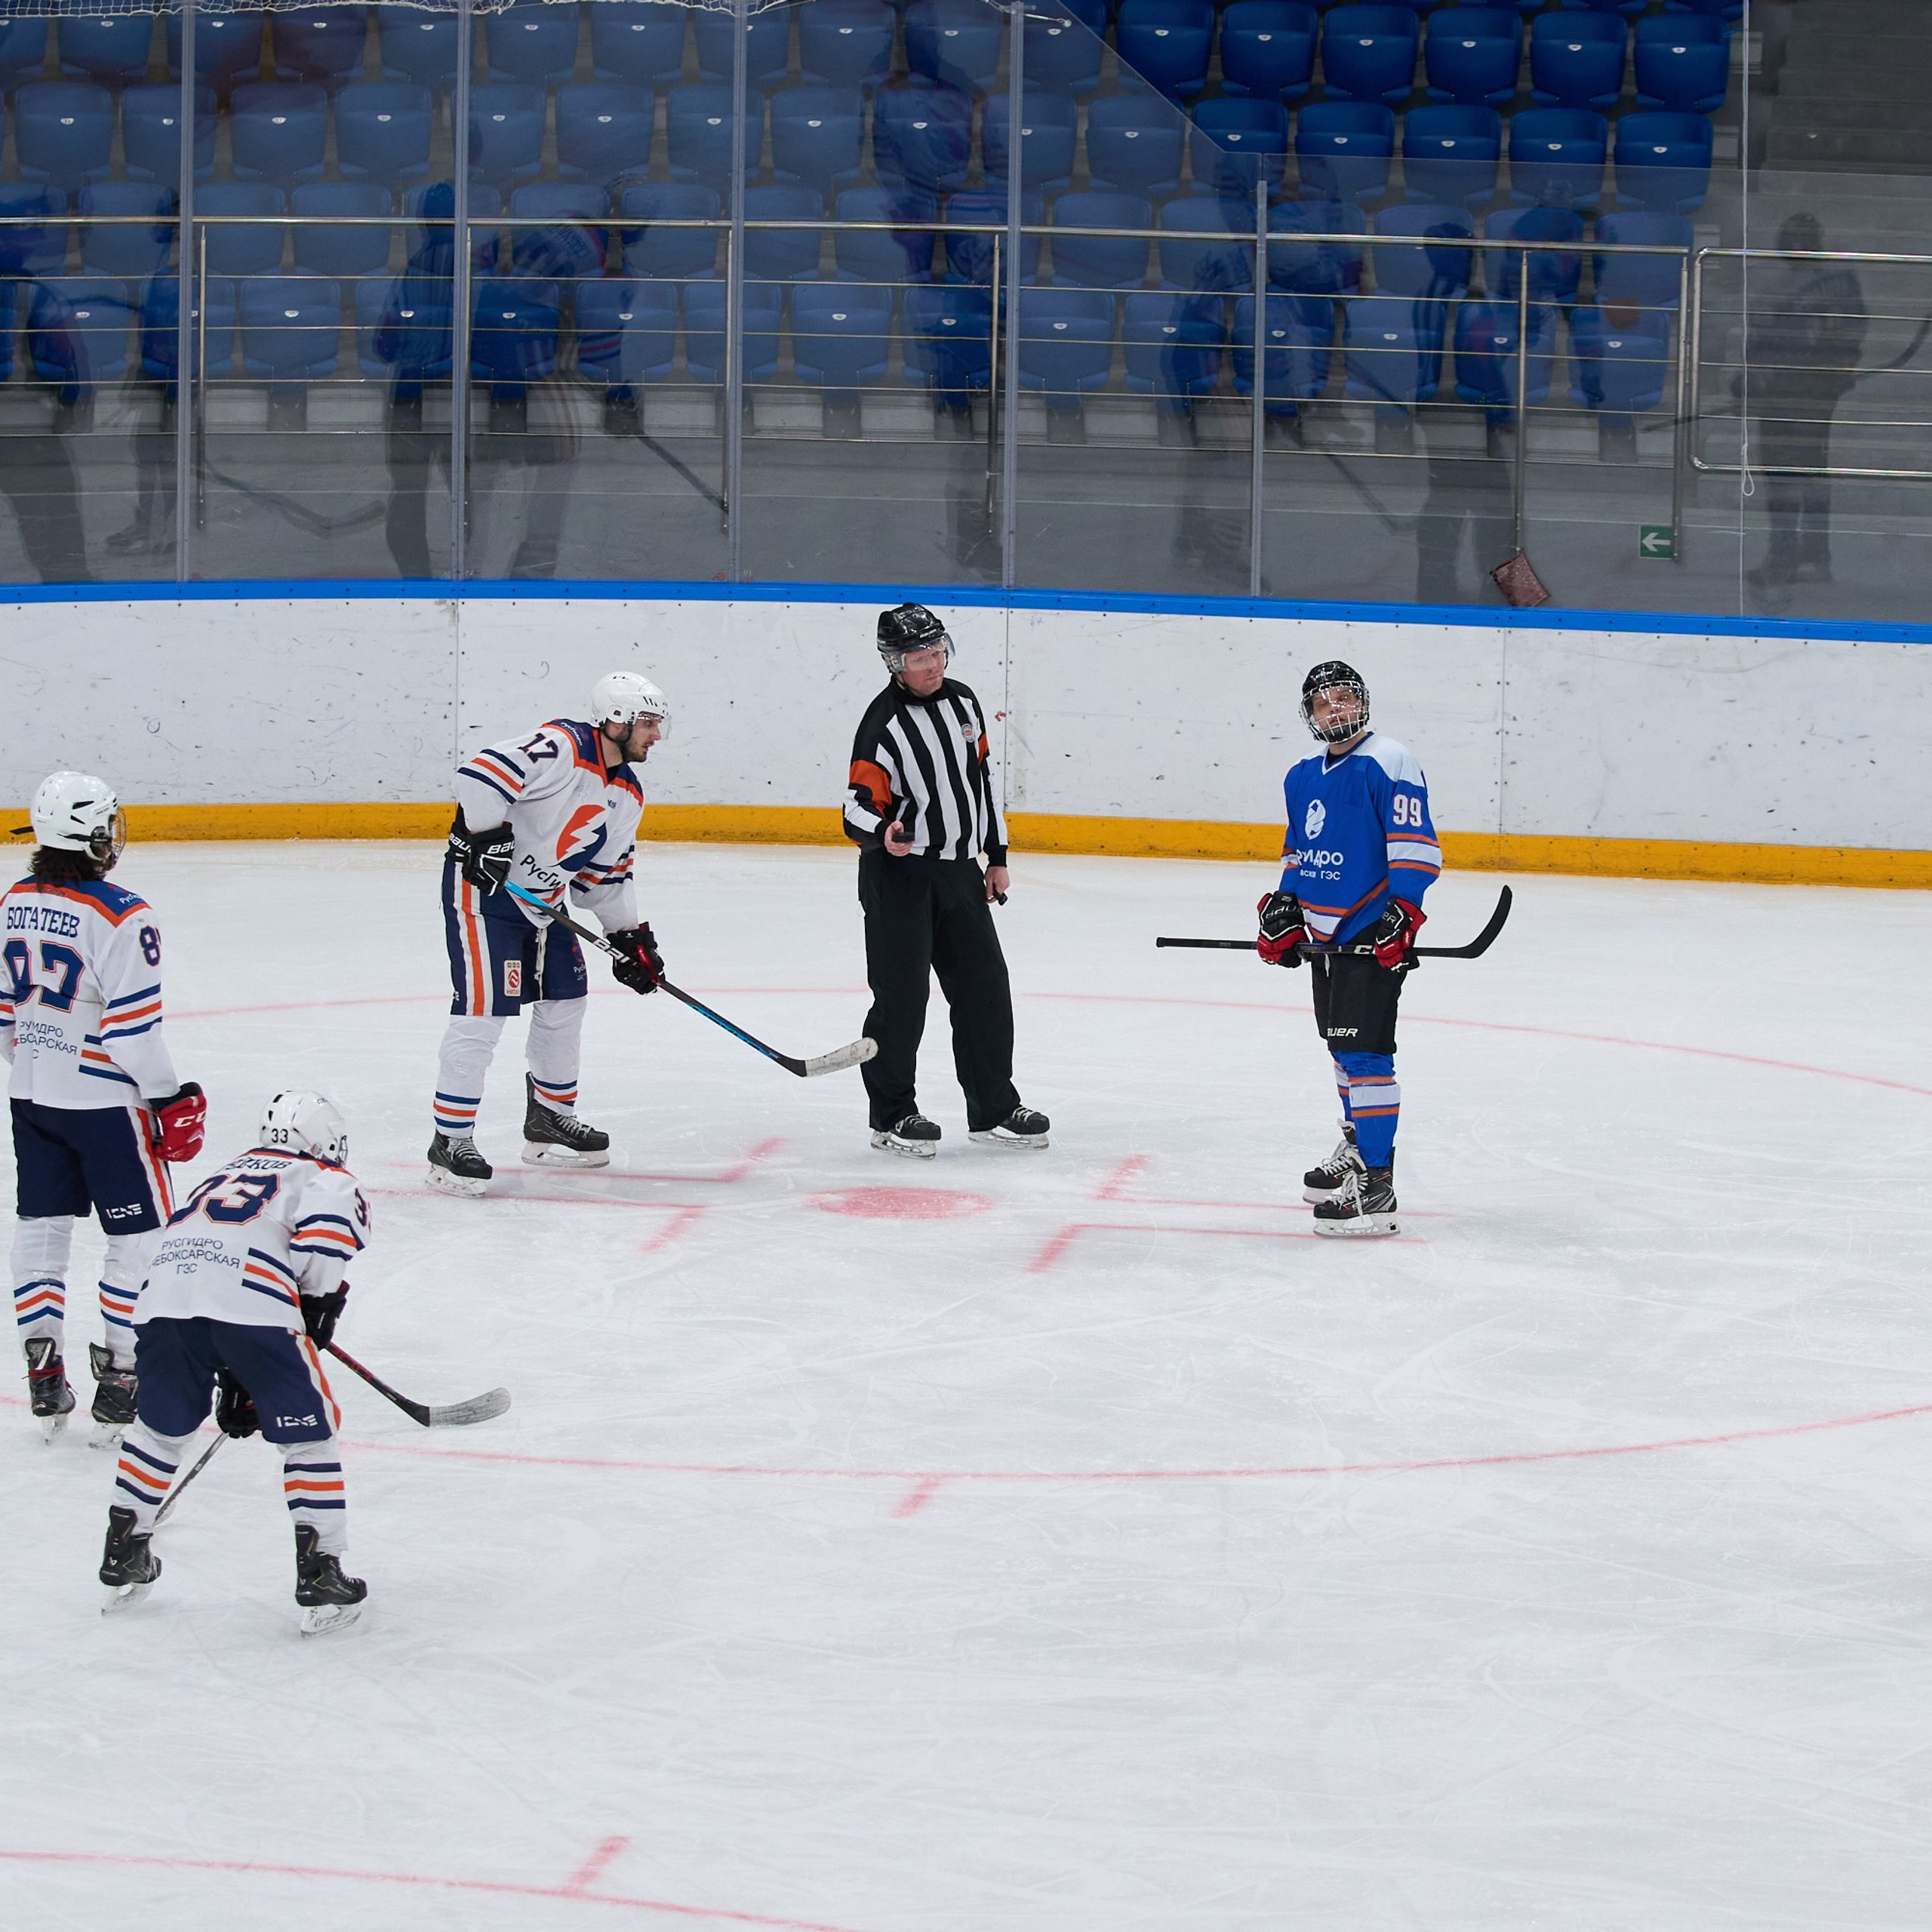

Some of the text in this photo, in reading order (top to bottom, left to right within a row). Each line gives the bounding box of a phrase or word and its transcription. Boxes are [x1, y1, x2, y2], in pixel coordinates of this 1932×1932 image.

[516, 732, 558, 764] 17
[1392, 794, 1423, 827] 99
[449, 833, 471, 854] BAU
[519, 854, 561, 888] РусГи
[1320, 870, 1341, 881] ГЭС
[7, 906, 80, 938] БОГАТЕЕВ
[139, 924, 162, 967] 8
[272, 1128, 289, 1143] 33
[162, 1237, 224, 1251] РУСГИДРО
